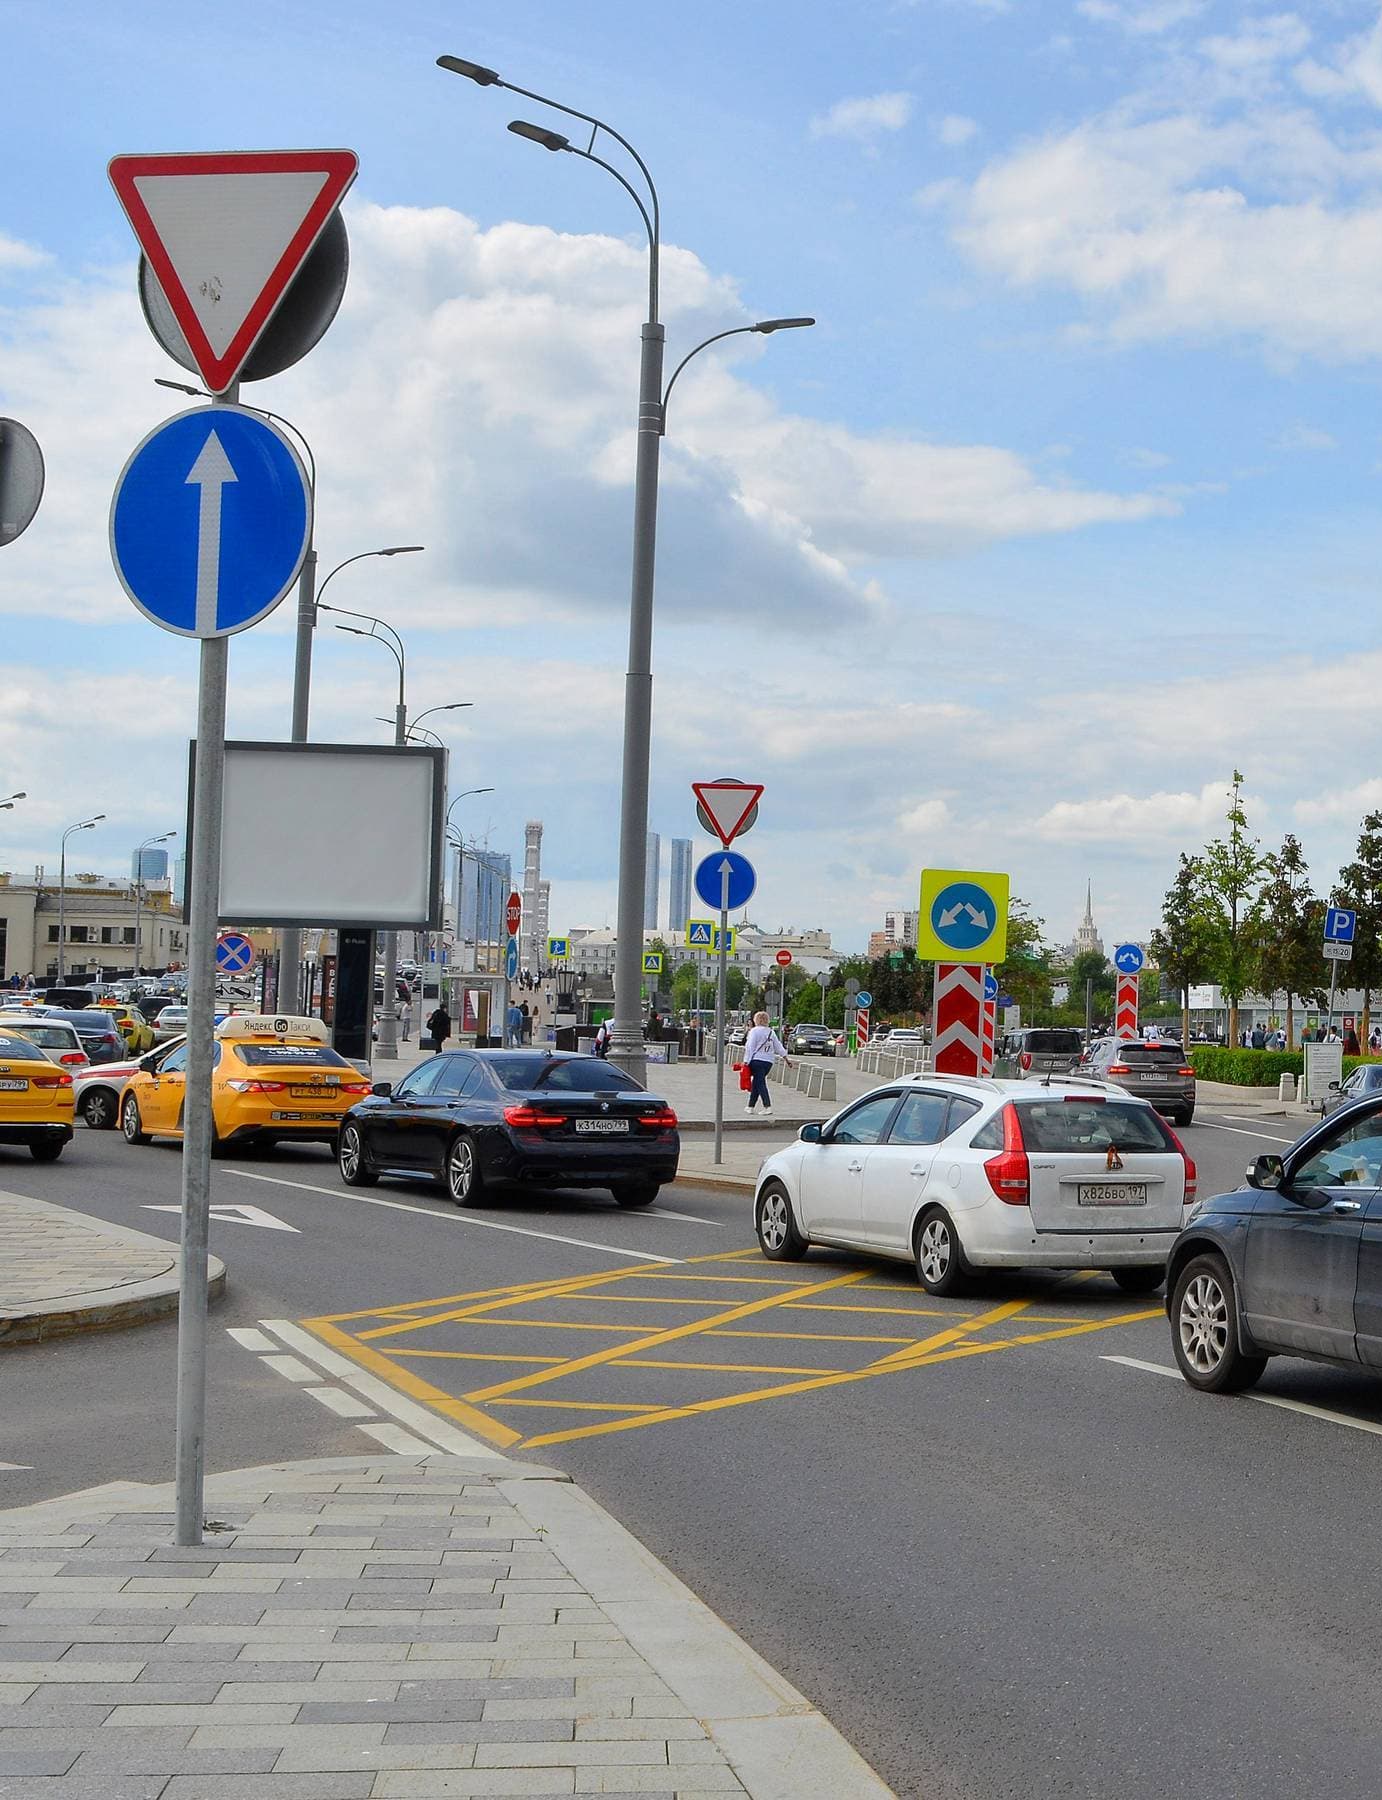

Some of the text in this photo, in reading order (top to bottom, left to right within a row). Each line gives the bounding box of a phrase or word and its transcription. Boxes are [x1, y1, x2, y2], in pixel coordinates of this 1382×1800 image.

[507, 906, 520, 920] STOP
[1332, 912, 1350, 936] P
[244, 1020, 311, 1031] Яндекс Go Такси
[1083, 1185, 1143, 1200] Х826ВО 197
